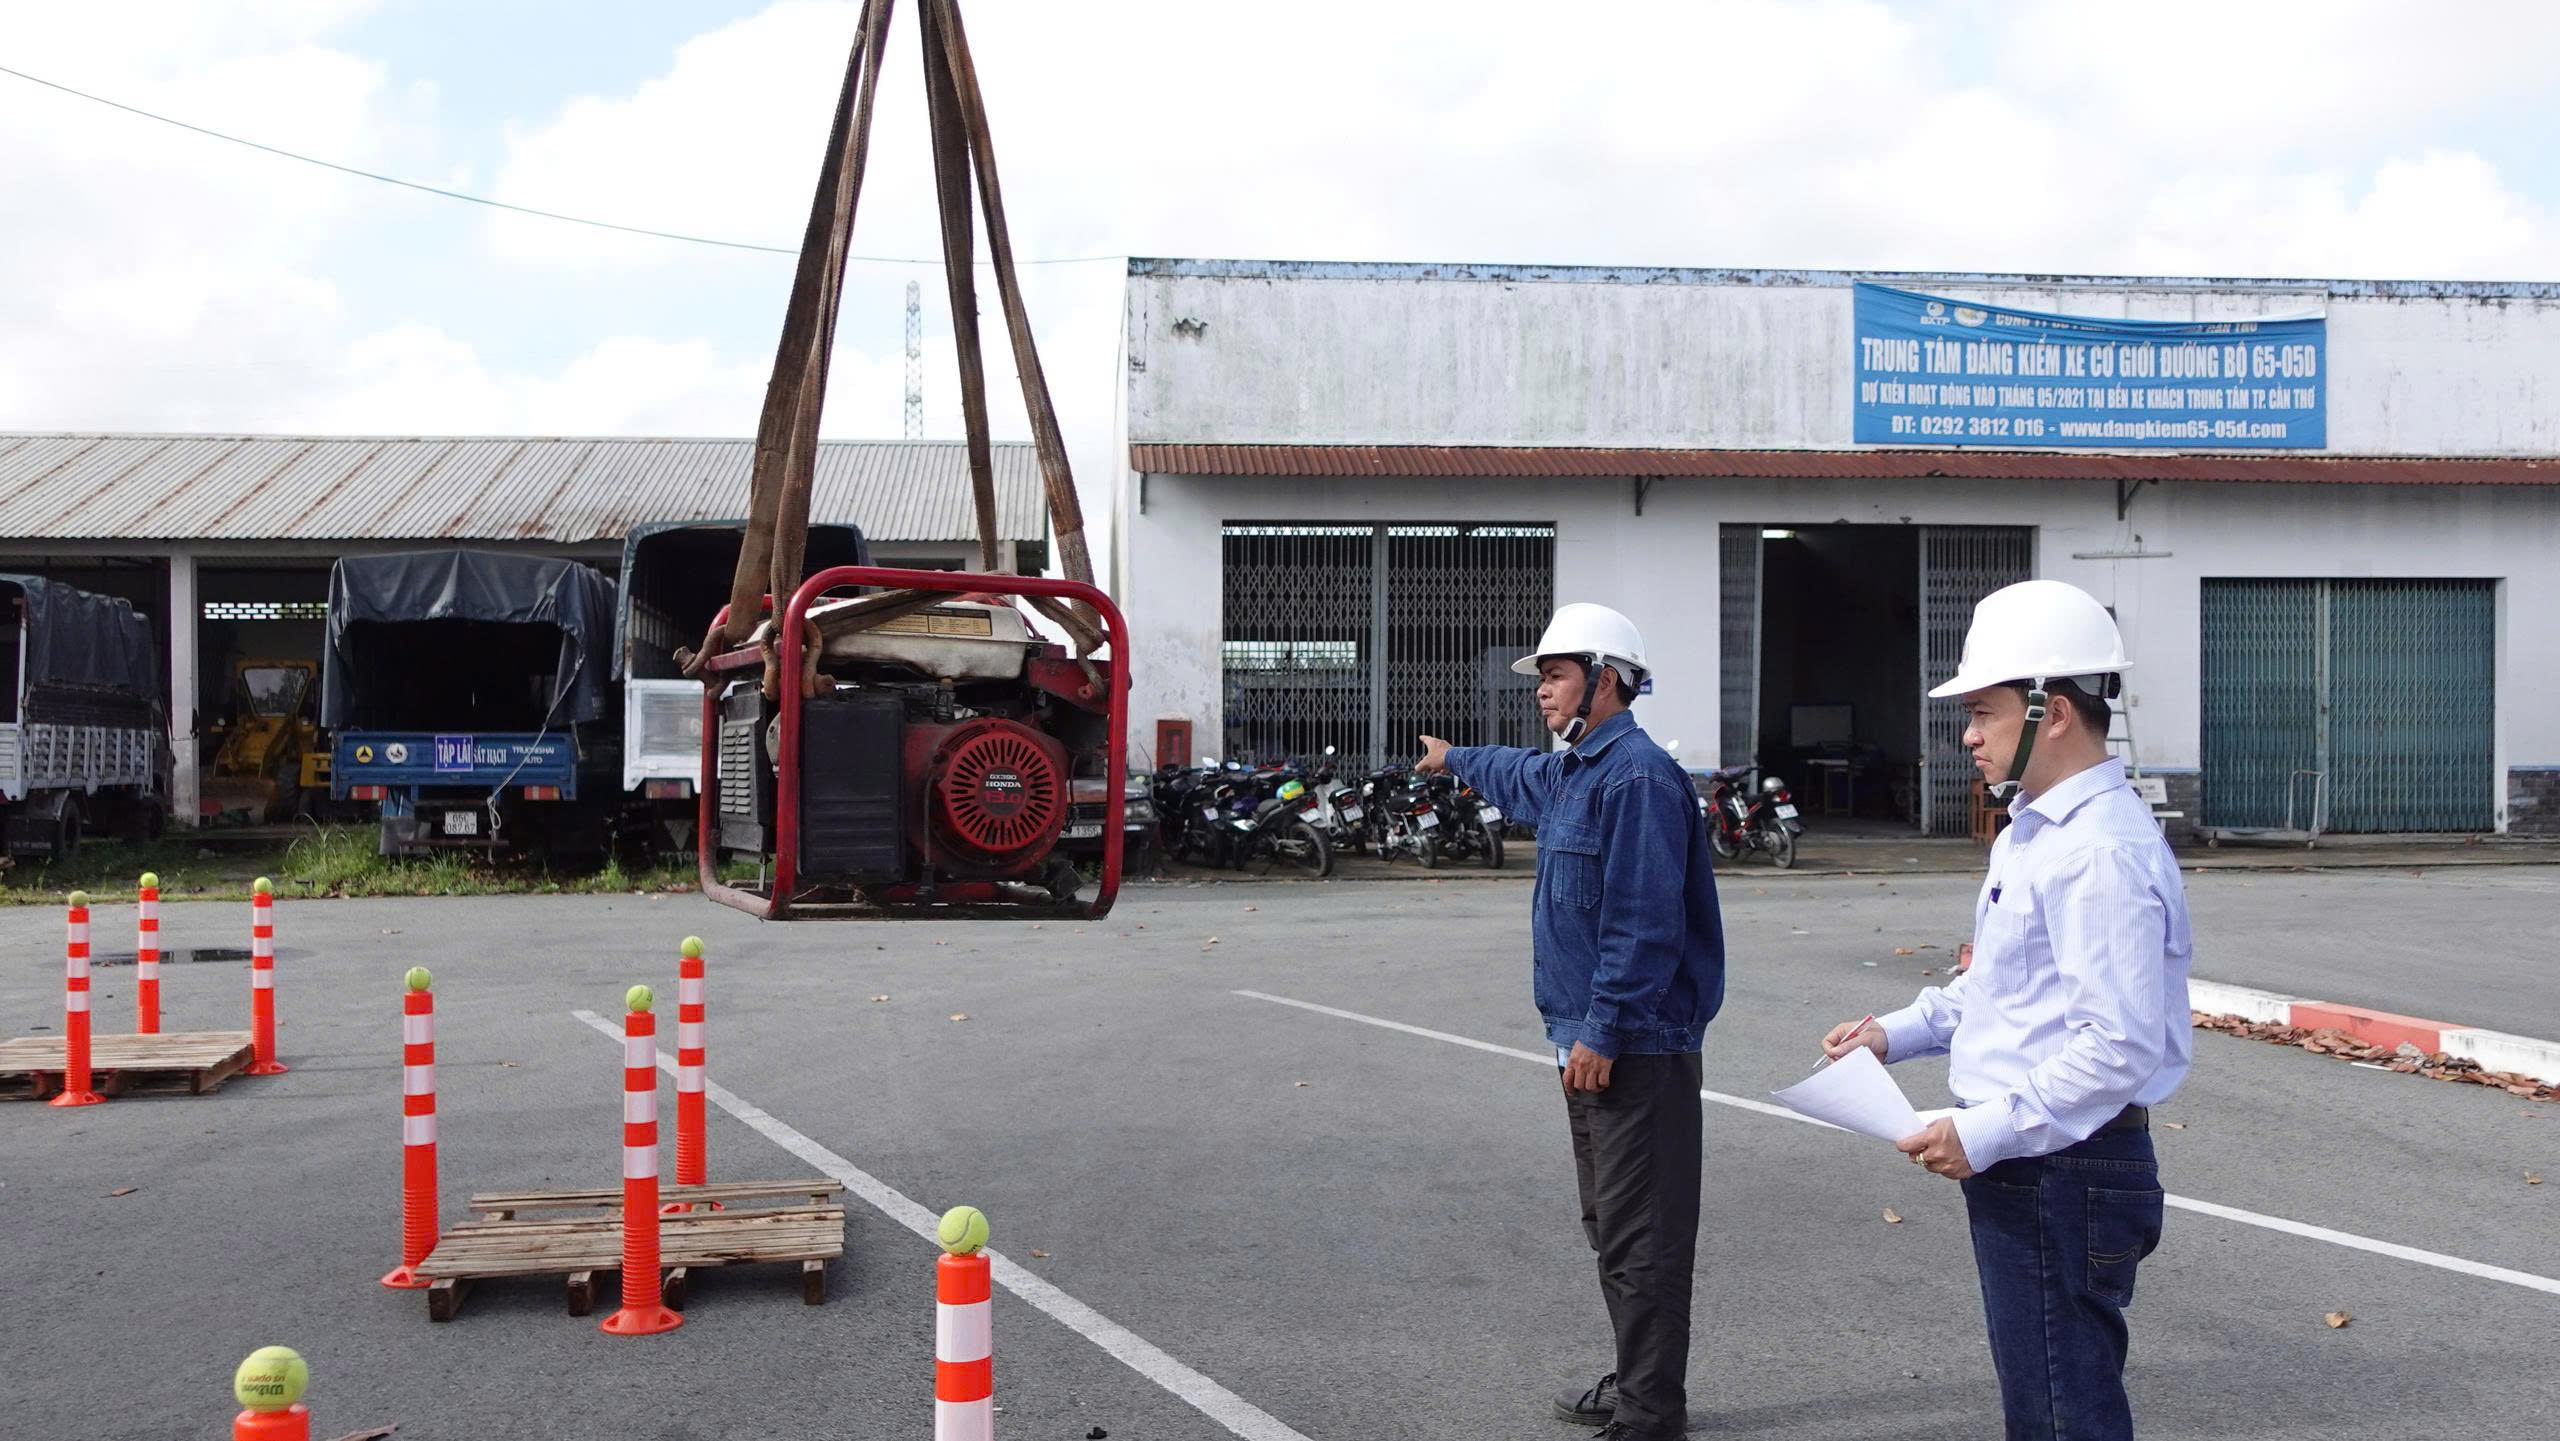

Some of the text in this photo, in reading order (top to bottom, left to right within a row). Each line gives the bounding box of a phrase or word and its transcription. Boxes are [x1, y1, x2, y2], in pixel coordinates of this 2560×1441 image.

[1861, 337, 1920, 373] TRUNG
[1925, 336, 1961, 375] TÂM
[1966, 336, 2013, 375] ĐĂNG
[2018, 333, 2061, 377] KIỂM
[2065, 344, 2086, 377] XE
[2090, 341, 2115, 378] CƠ
[2120, 340, 2155, 378] GIỚI
[2224, 340, 2248, 384] BỘ
[2252, 345, 2316, 379] 65-05D
[1861, 377, 2316, 412] DỰ KIẾN HOẠT ĐỘNG VÀO THÁNG 05/2021 TẠI BẾN XE KHÁCH TRUNG TÂM TP. CẦN THƠ
[1891, 415, 1916, 434] ĐT:
[1921, 416, 1964, 435] 0292
[1969, 417, 2009, 437] 3812
[2014, 418, 2044, 437] 016
[2060, 420, 2287, 440] www.dangkiem65-05d.com
[438, 738, 472, 768] TẬP LÁI
